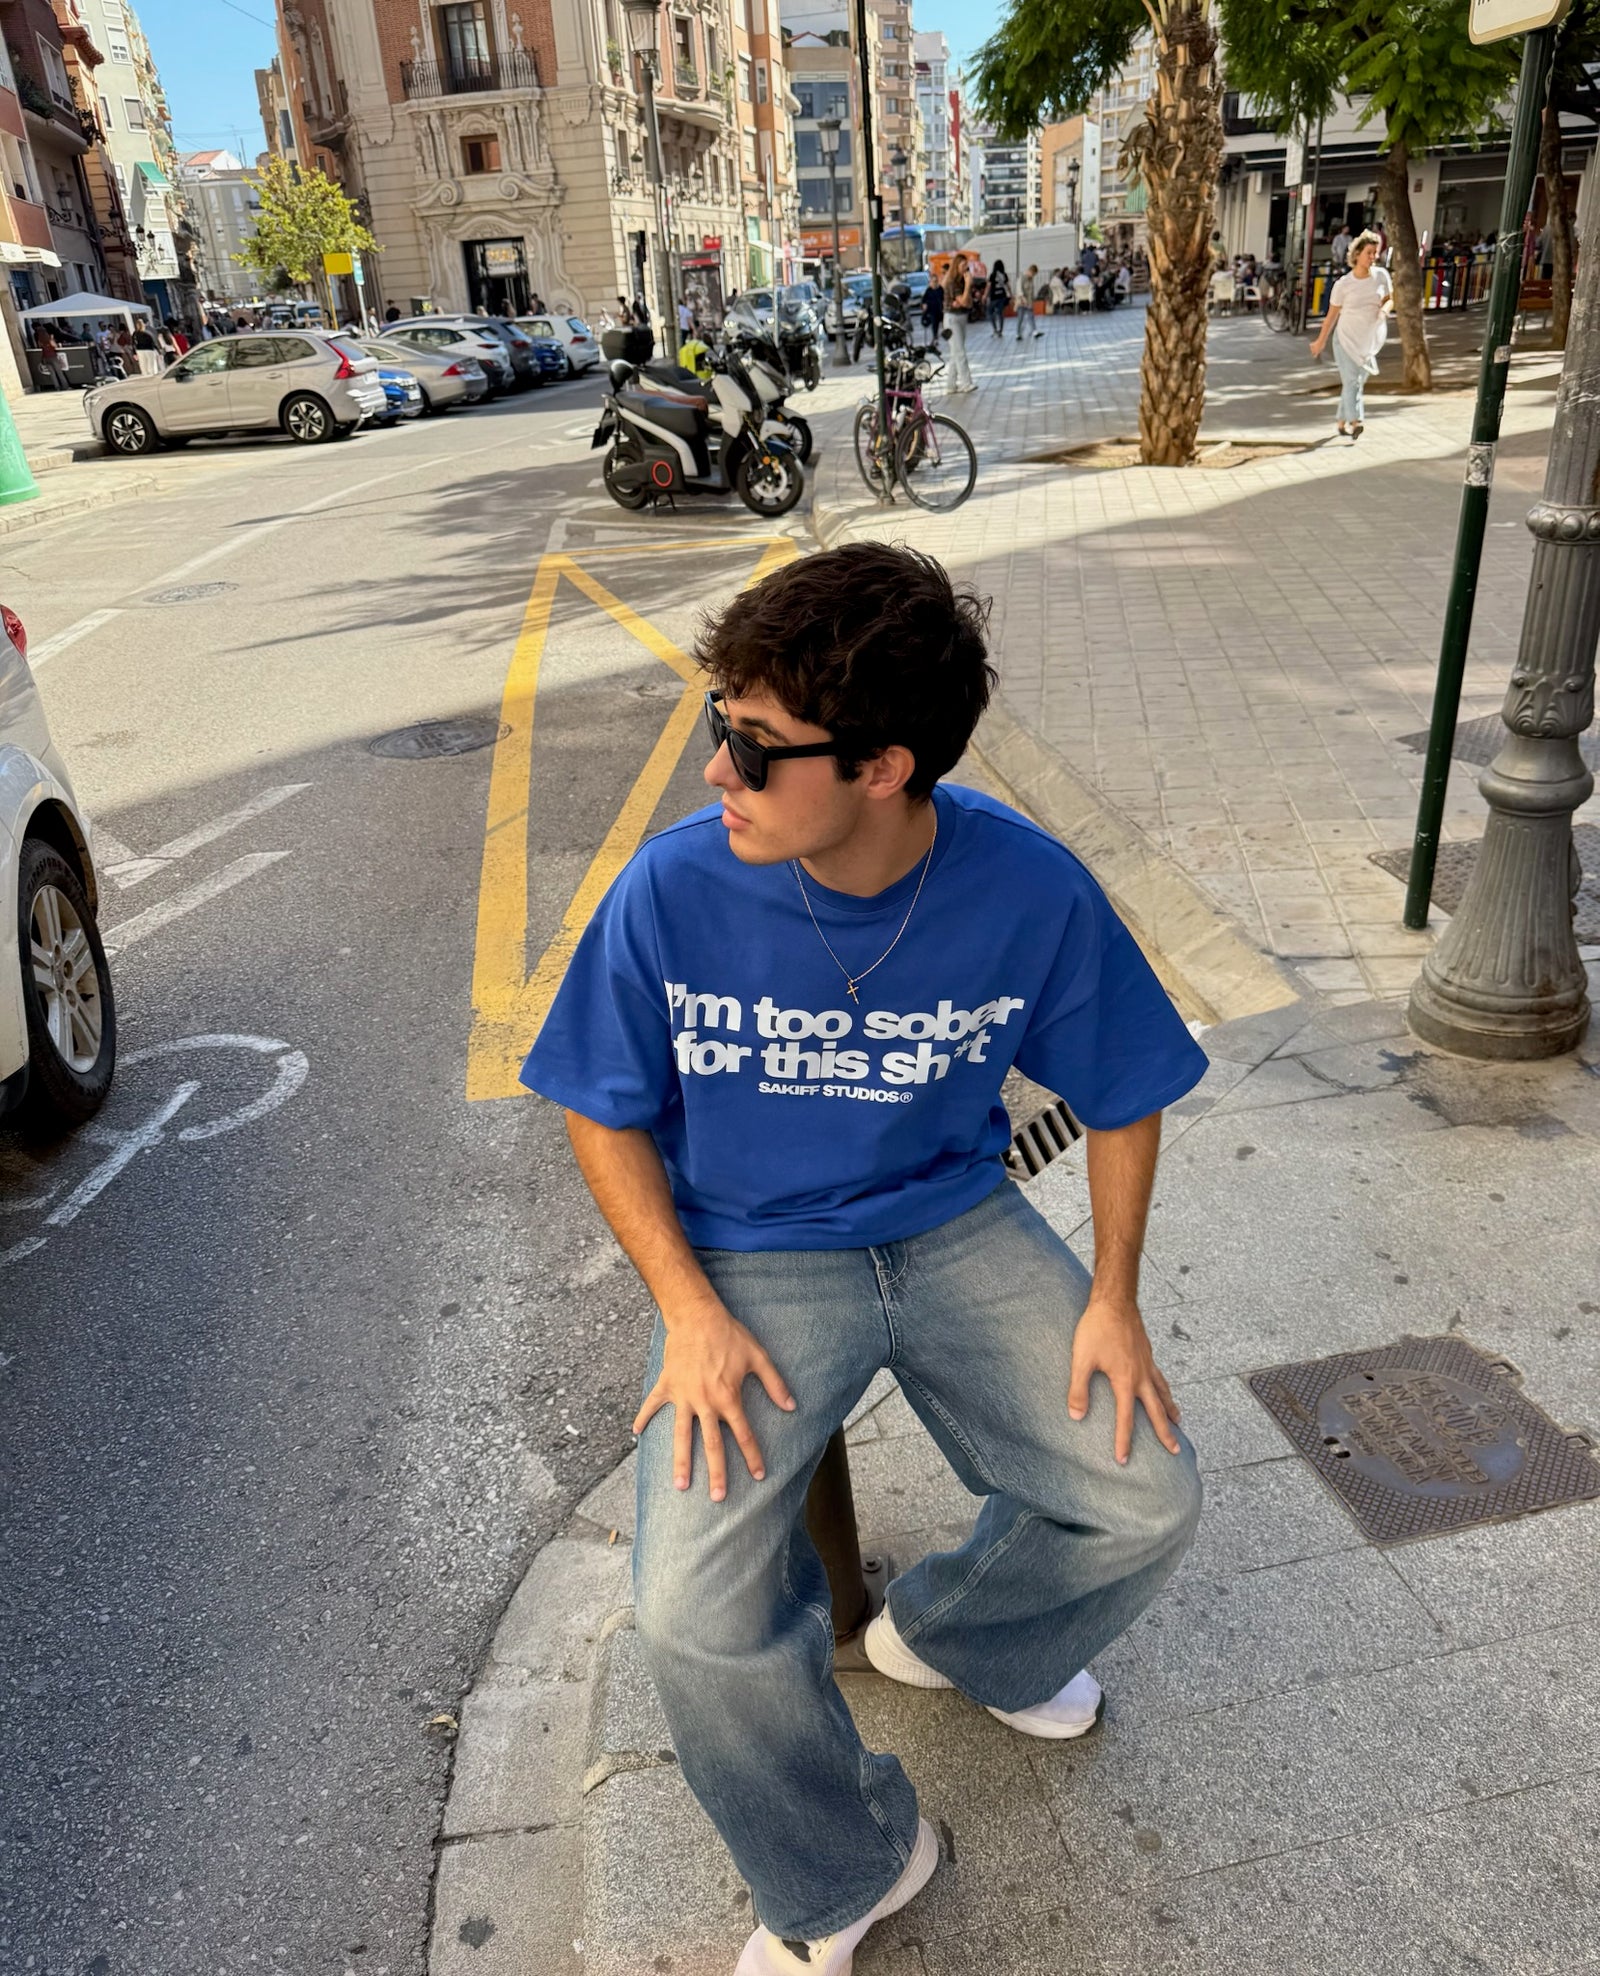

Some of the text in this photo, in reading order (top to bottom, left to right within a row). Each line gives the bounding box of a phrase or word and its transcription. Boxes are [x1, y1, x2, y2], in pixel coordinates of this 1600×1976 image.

[753, 996, 853, 1040] too
[863, 996, 1025, 1041] sober
[673, 1031, 752, 1076] for
[760, 1041, 870, 1080] this
[758, 1082, 820, 1096] SAKIFF
